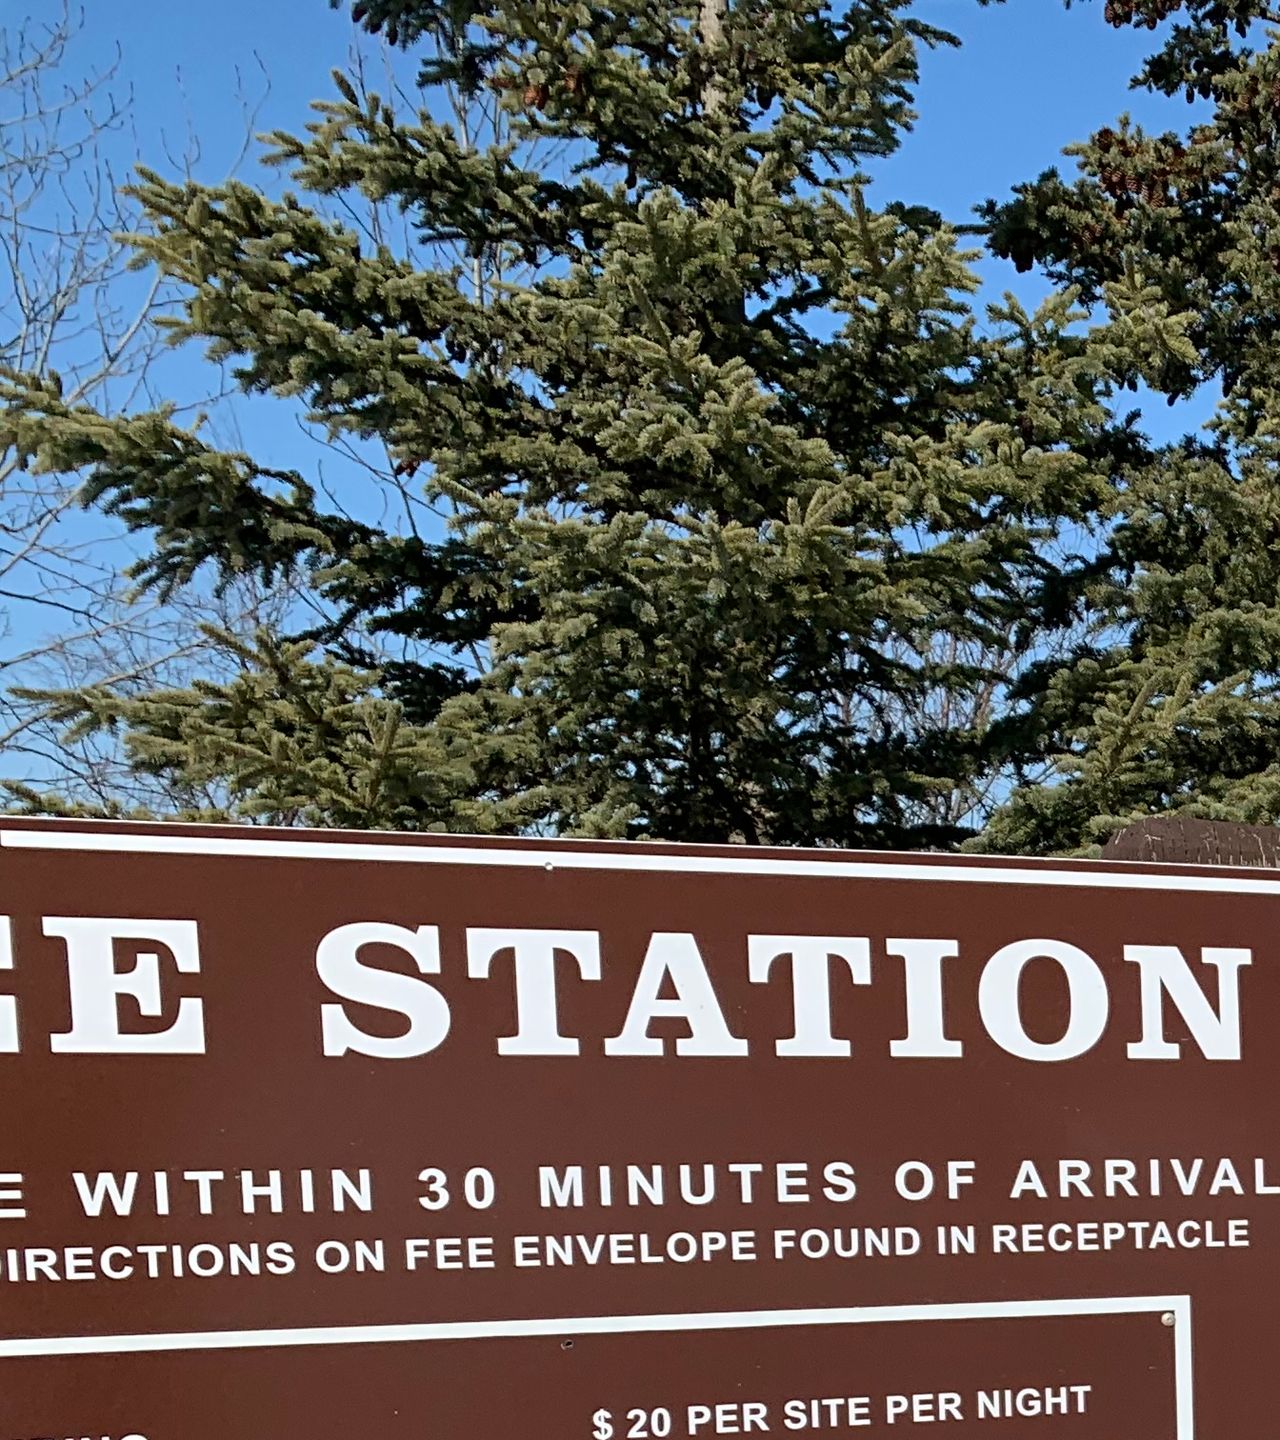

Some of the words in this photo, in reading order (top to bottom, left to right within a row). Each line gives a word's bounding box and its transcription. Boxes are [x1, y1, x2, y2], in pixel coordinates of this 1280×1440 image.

[0, 915, 206, 1055] E
[315, 921, 1253, 1062] STATION
[72, 1168, 372, 1217] WITHIN
[418, 1167, 495, 1211] 30
[538, 1161, 857, 1208] MINUTES
[894, 1160, 976, 1201] OF
[0, 1241, 296, 1282] IRECTIONS
[315, 1239, 385, 1273] ON
[405, 1237, 496, 1271] FEE
[513, 1230, 757, 1267] ENVELOPE
[774, 1226, 921, 1260] FOUND
[937, 1225, 975, 1255] IN
[992, 1219, 1250, 1253] RECEPTACLE
[626, 1407, 672, 1439] 20
[687, 1402, 770, 1436] PER
[783, 1396, 872, 1430] SITE
[886, 1392, 964, 1424] PER
[977, 1384, 1092, 1419] NIGHT
